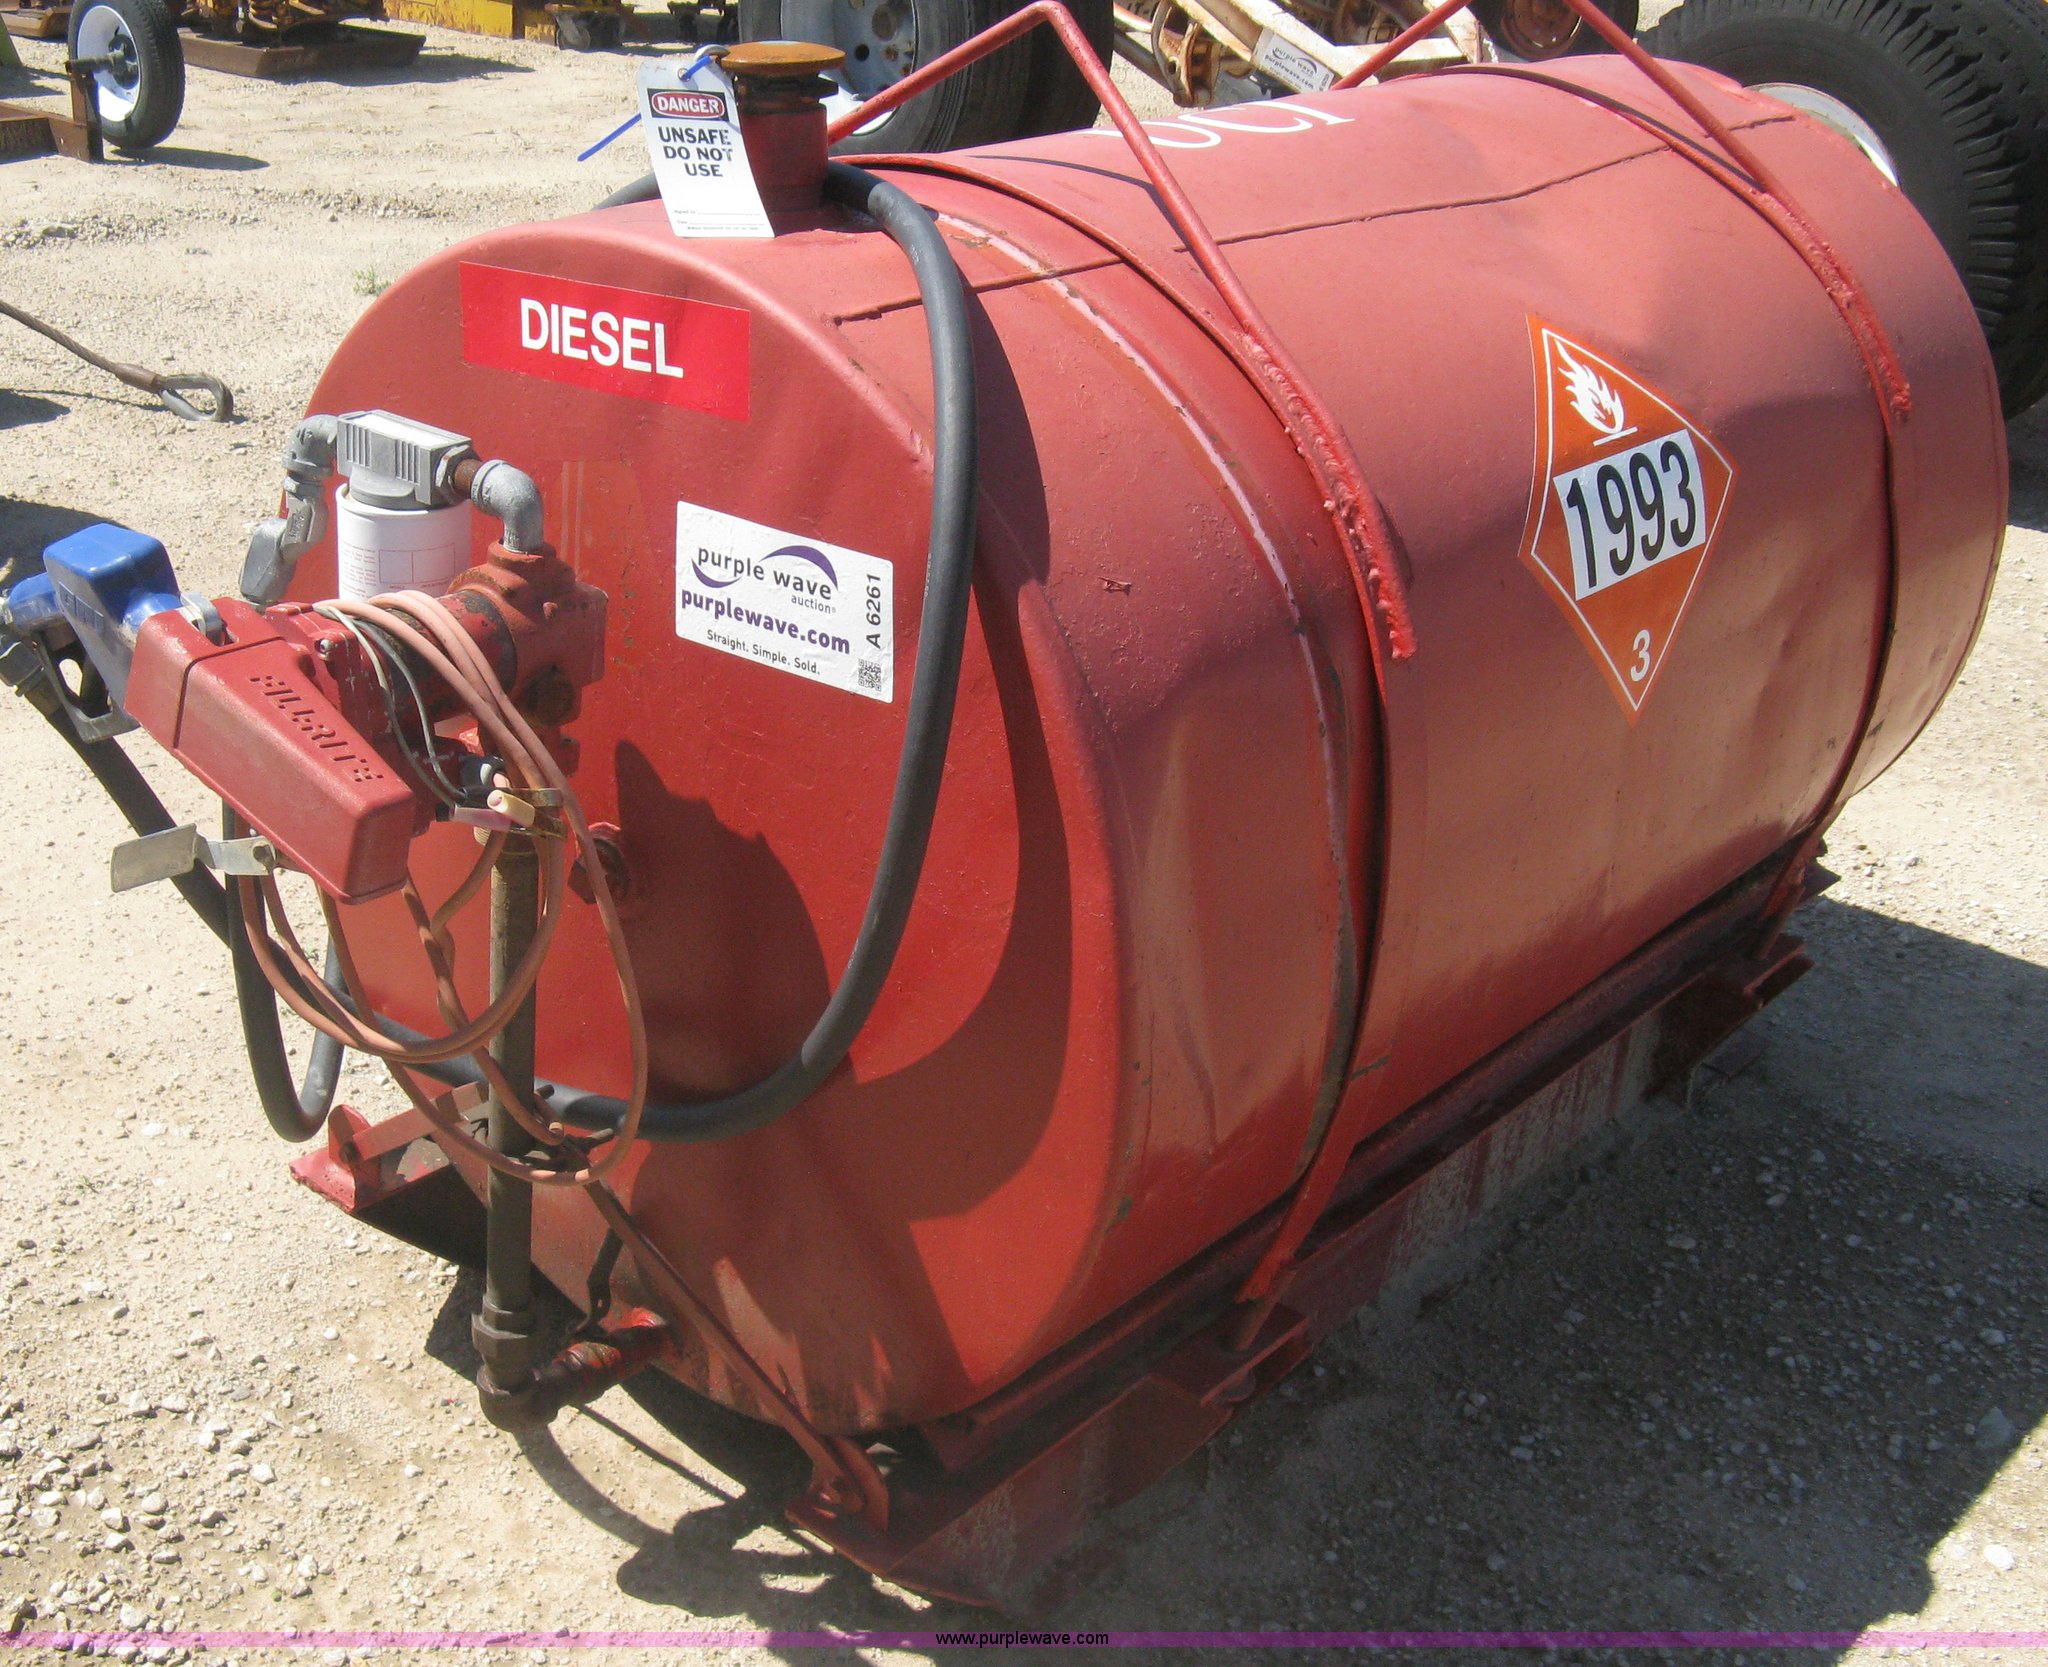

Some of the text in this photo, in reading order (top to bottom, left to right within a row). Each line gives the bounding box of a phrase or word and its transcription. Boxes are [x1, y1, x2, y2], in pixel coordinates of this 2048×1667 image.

[657, 96, 720, 114] DANGER
[657, 126, 732, 146] UNSAFE
[663, 145, 733, 162] DO NOT
[684, 162, 723, 177] USE
[520, 298, 684, 378] DIESEL
[1566, 440, 1696, 589] 1993
[698, 546, 832, 600] purple wave
[681, 588, 850, 654] purplewave.com
[866, 573, 882, 649] A 6261
[707, 629, 820, 675] Straight. Simple. Sold.
[1630, 629, 1651, 682] 3
